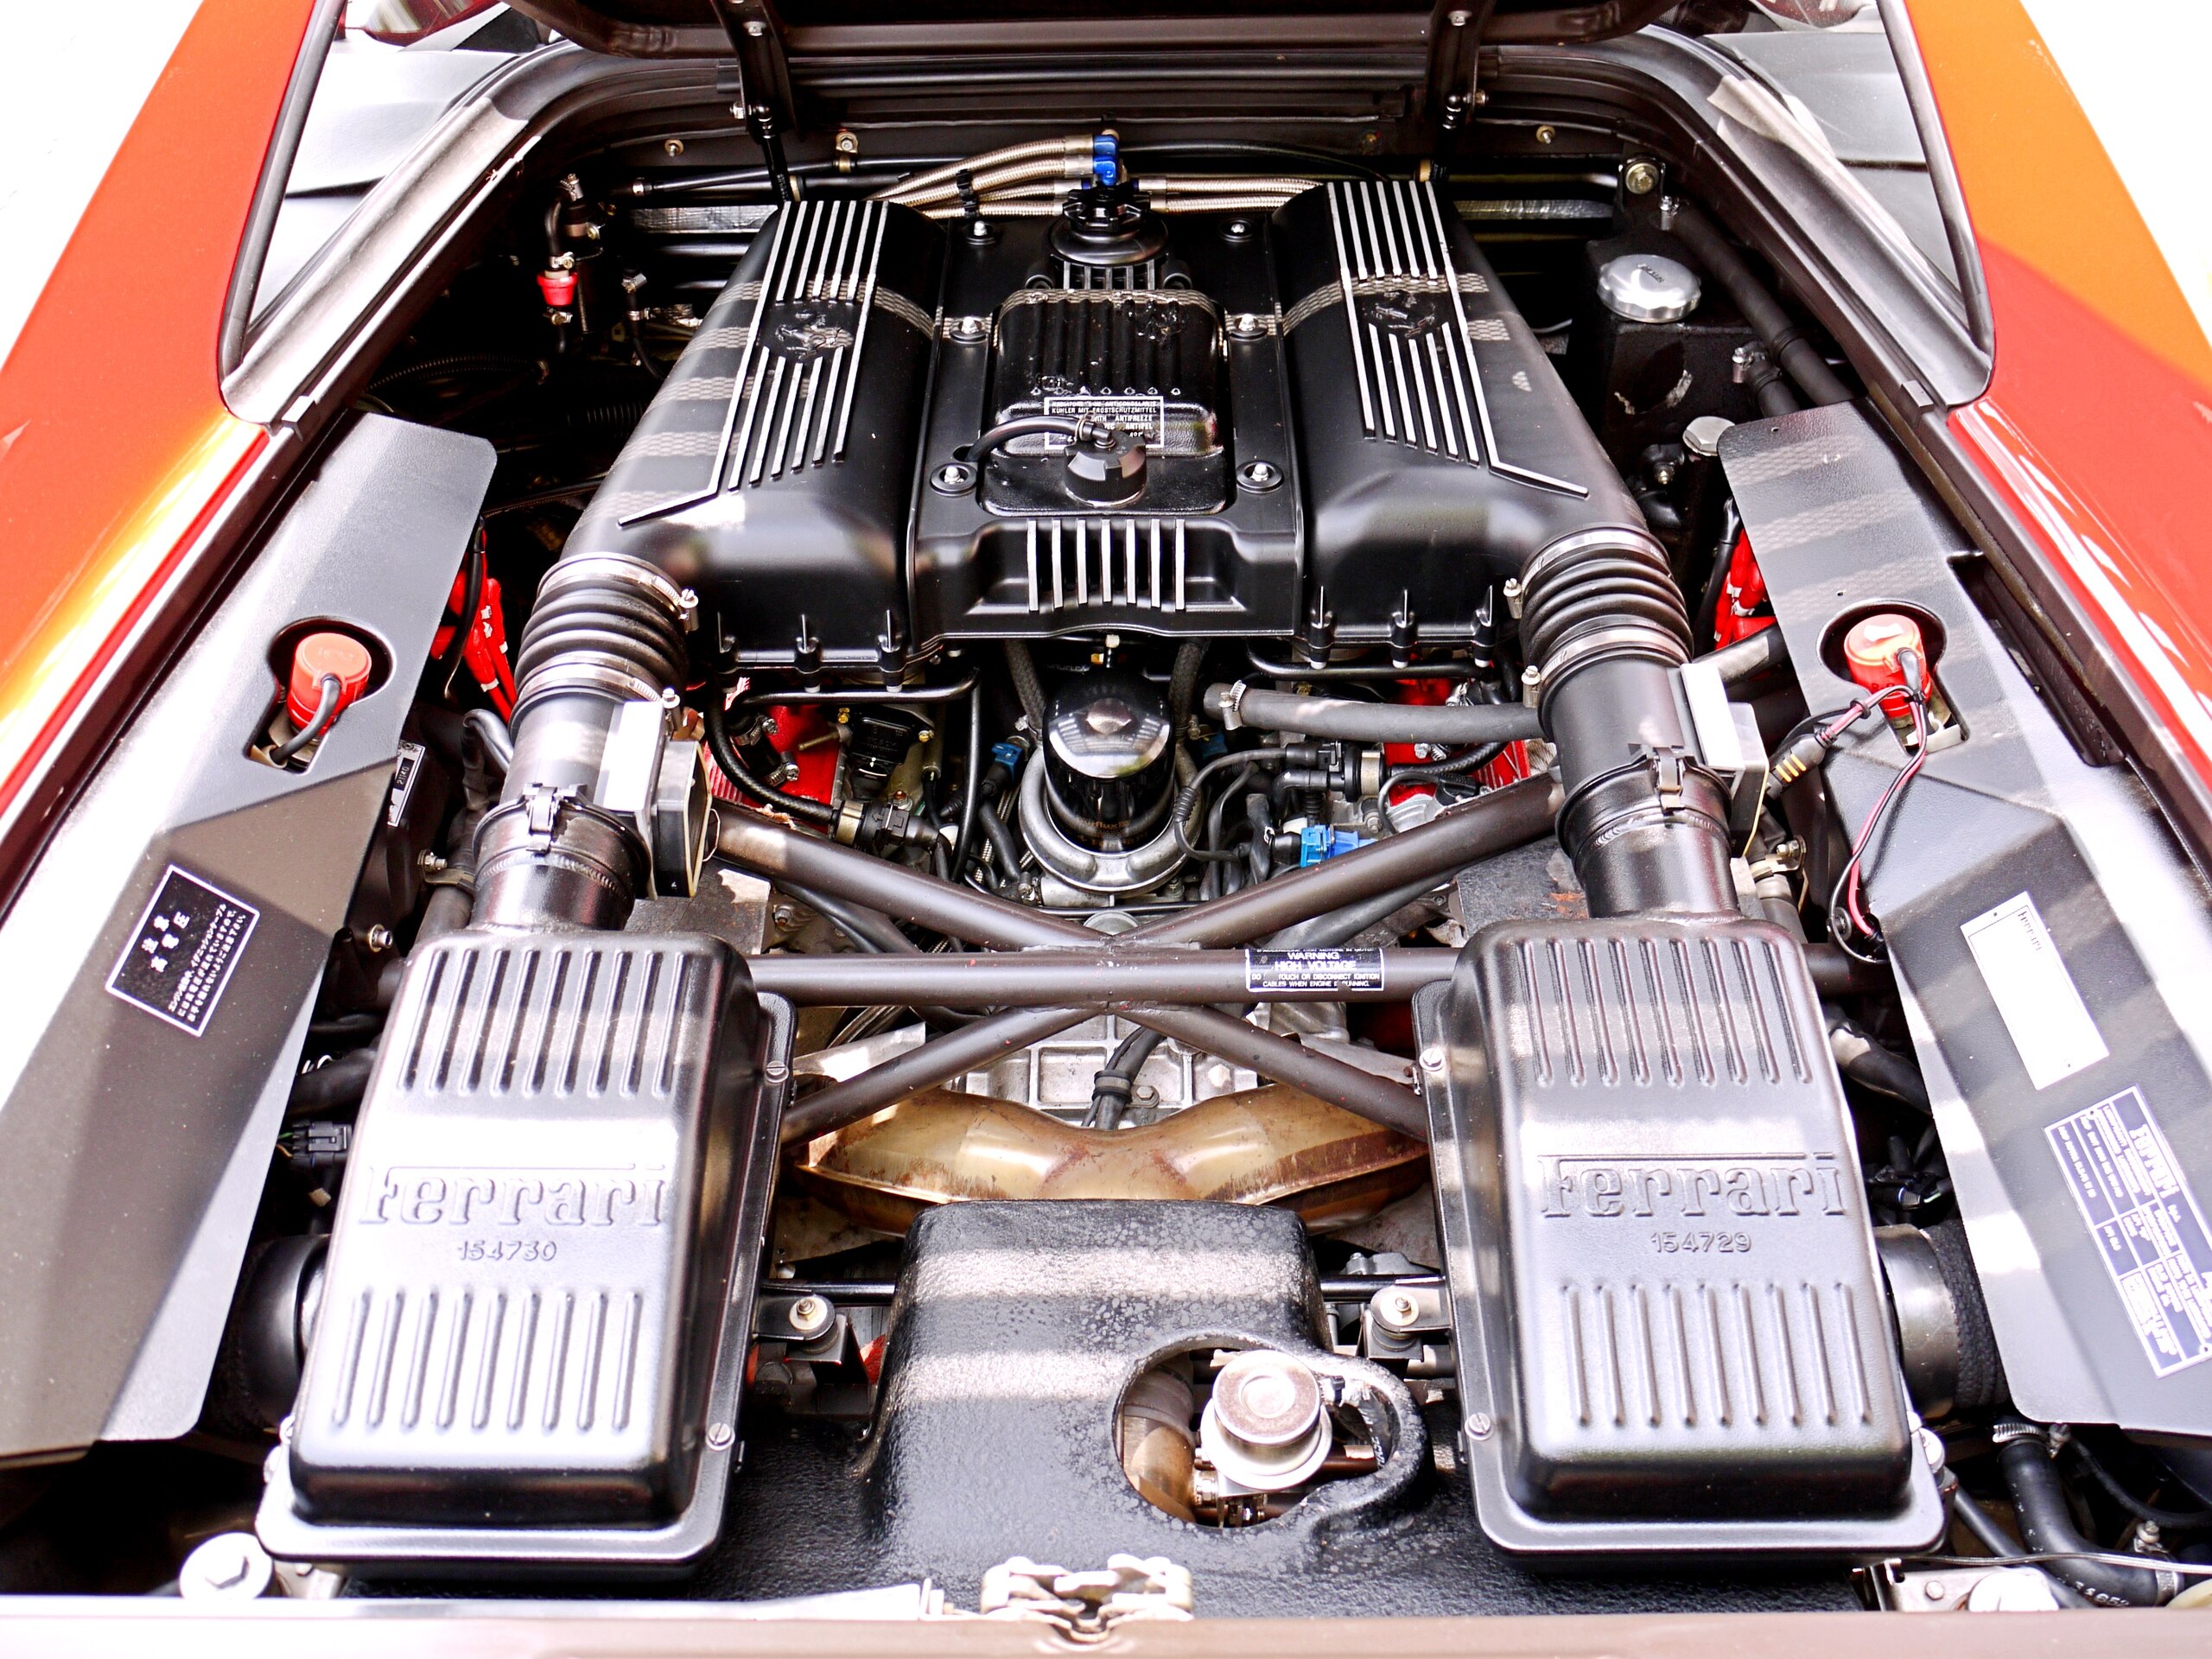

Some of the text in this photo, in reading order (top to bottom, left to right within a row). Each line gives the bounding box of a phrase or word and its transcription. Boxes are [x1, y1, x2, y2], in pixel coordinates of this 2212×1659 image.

[1274, 961, 1357, 971] HIGH VOLTAGE
[359, 1162, 665, 1225] Ferrari
[1538, 1153, 1845, 1217] Ferrari
[457, 1240, 558, 1262] 154730
[1650, 1231, 1752, 1254] 154729
